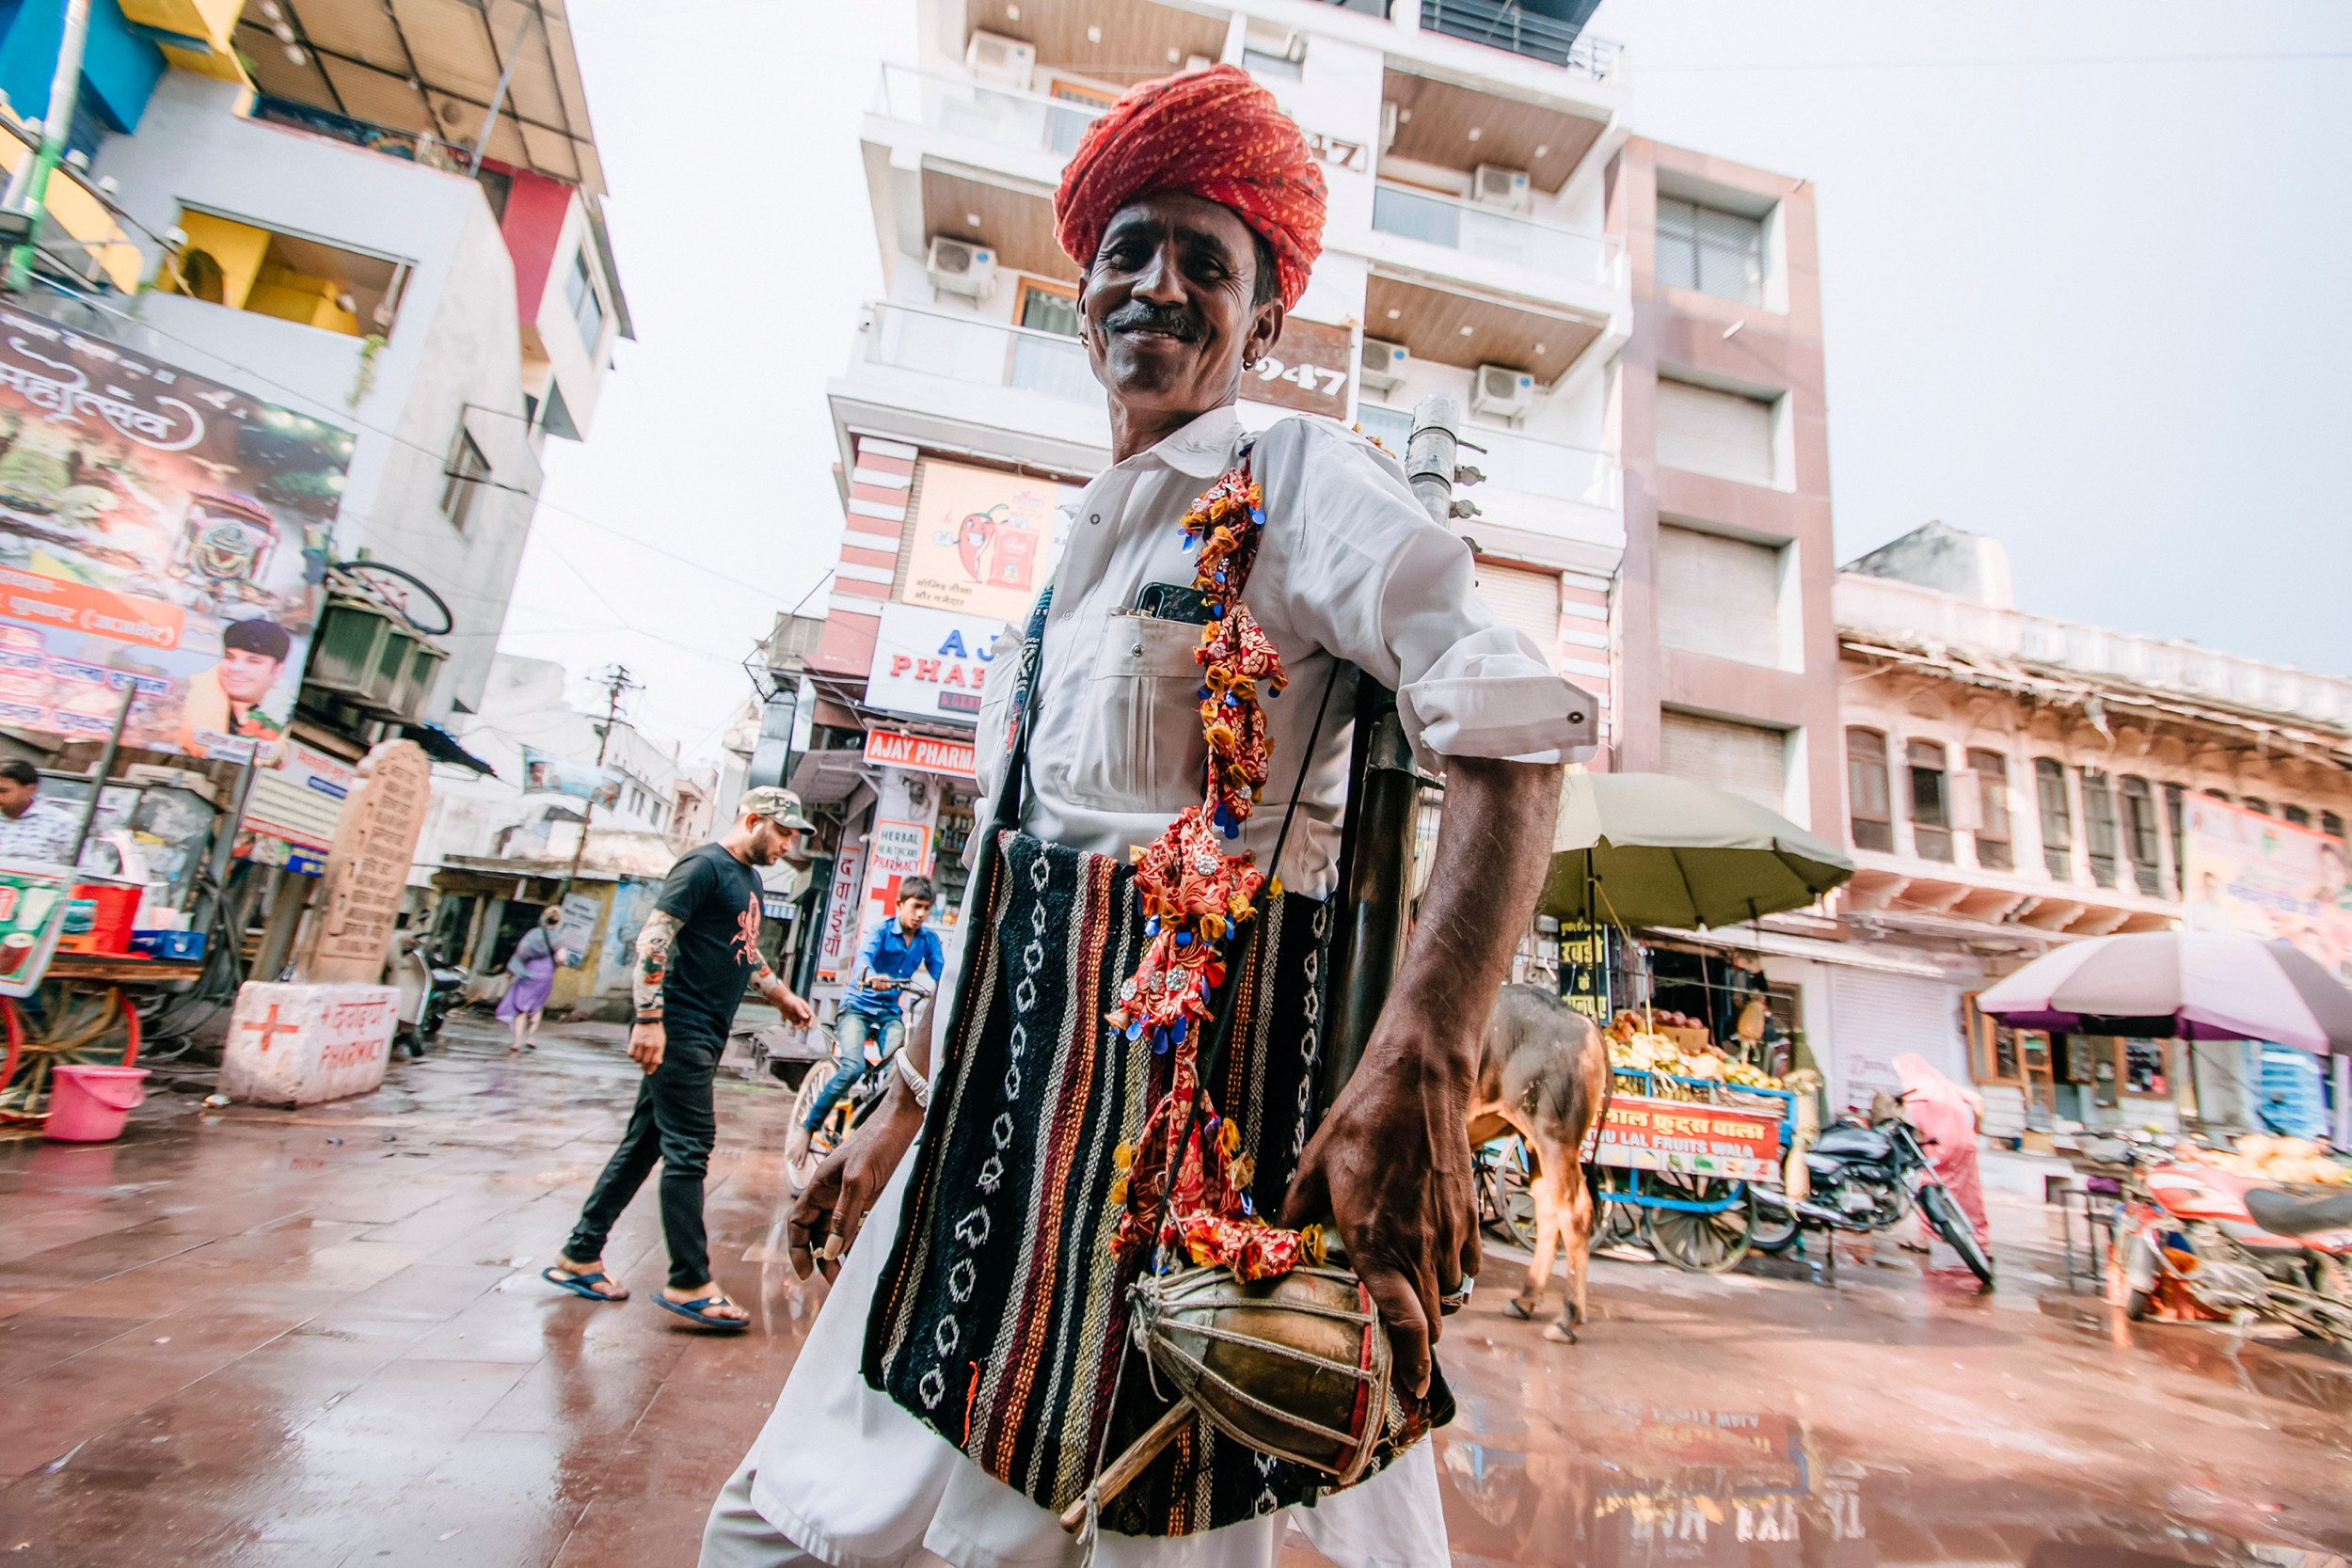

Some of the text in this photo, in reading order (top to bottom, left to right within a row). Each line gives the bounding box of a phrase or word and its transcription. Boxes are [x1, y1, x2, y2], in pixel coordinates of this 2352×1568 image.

[871, 736, 913, 760] AJAY
[881, 830, 918, 845] HERBAL
[872, 854, 921, 873] PHARMACY
[1711, 1119, 1767, 1141] वाला
[1619, 1131, 1649, 1148] LAL
[1652, 1134, 1708, 1154] FRUITS
[1709, 1140, 1756, 1159] WALA
